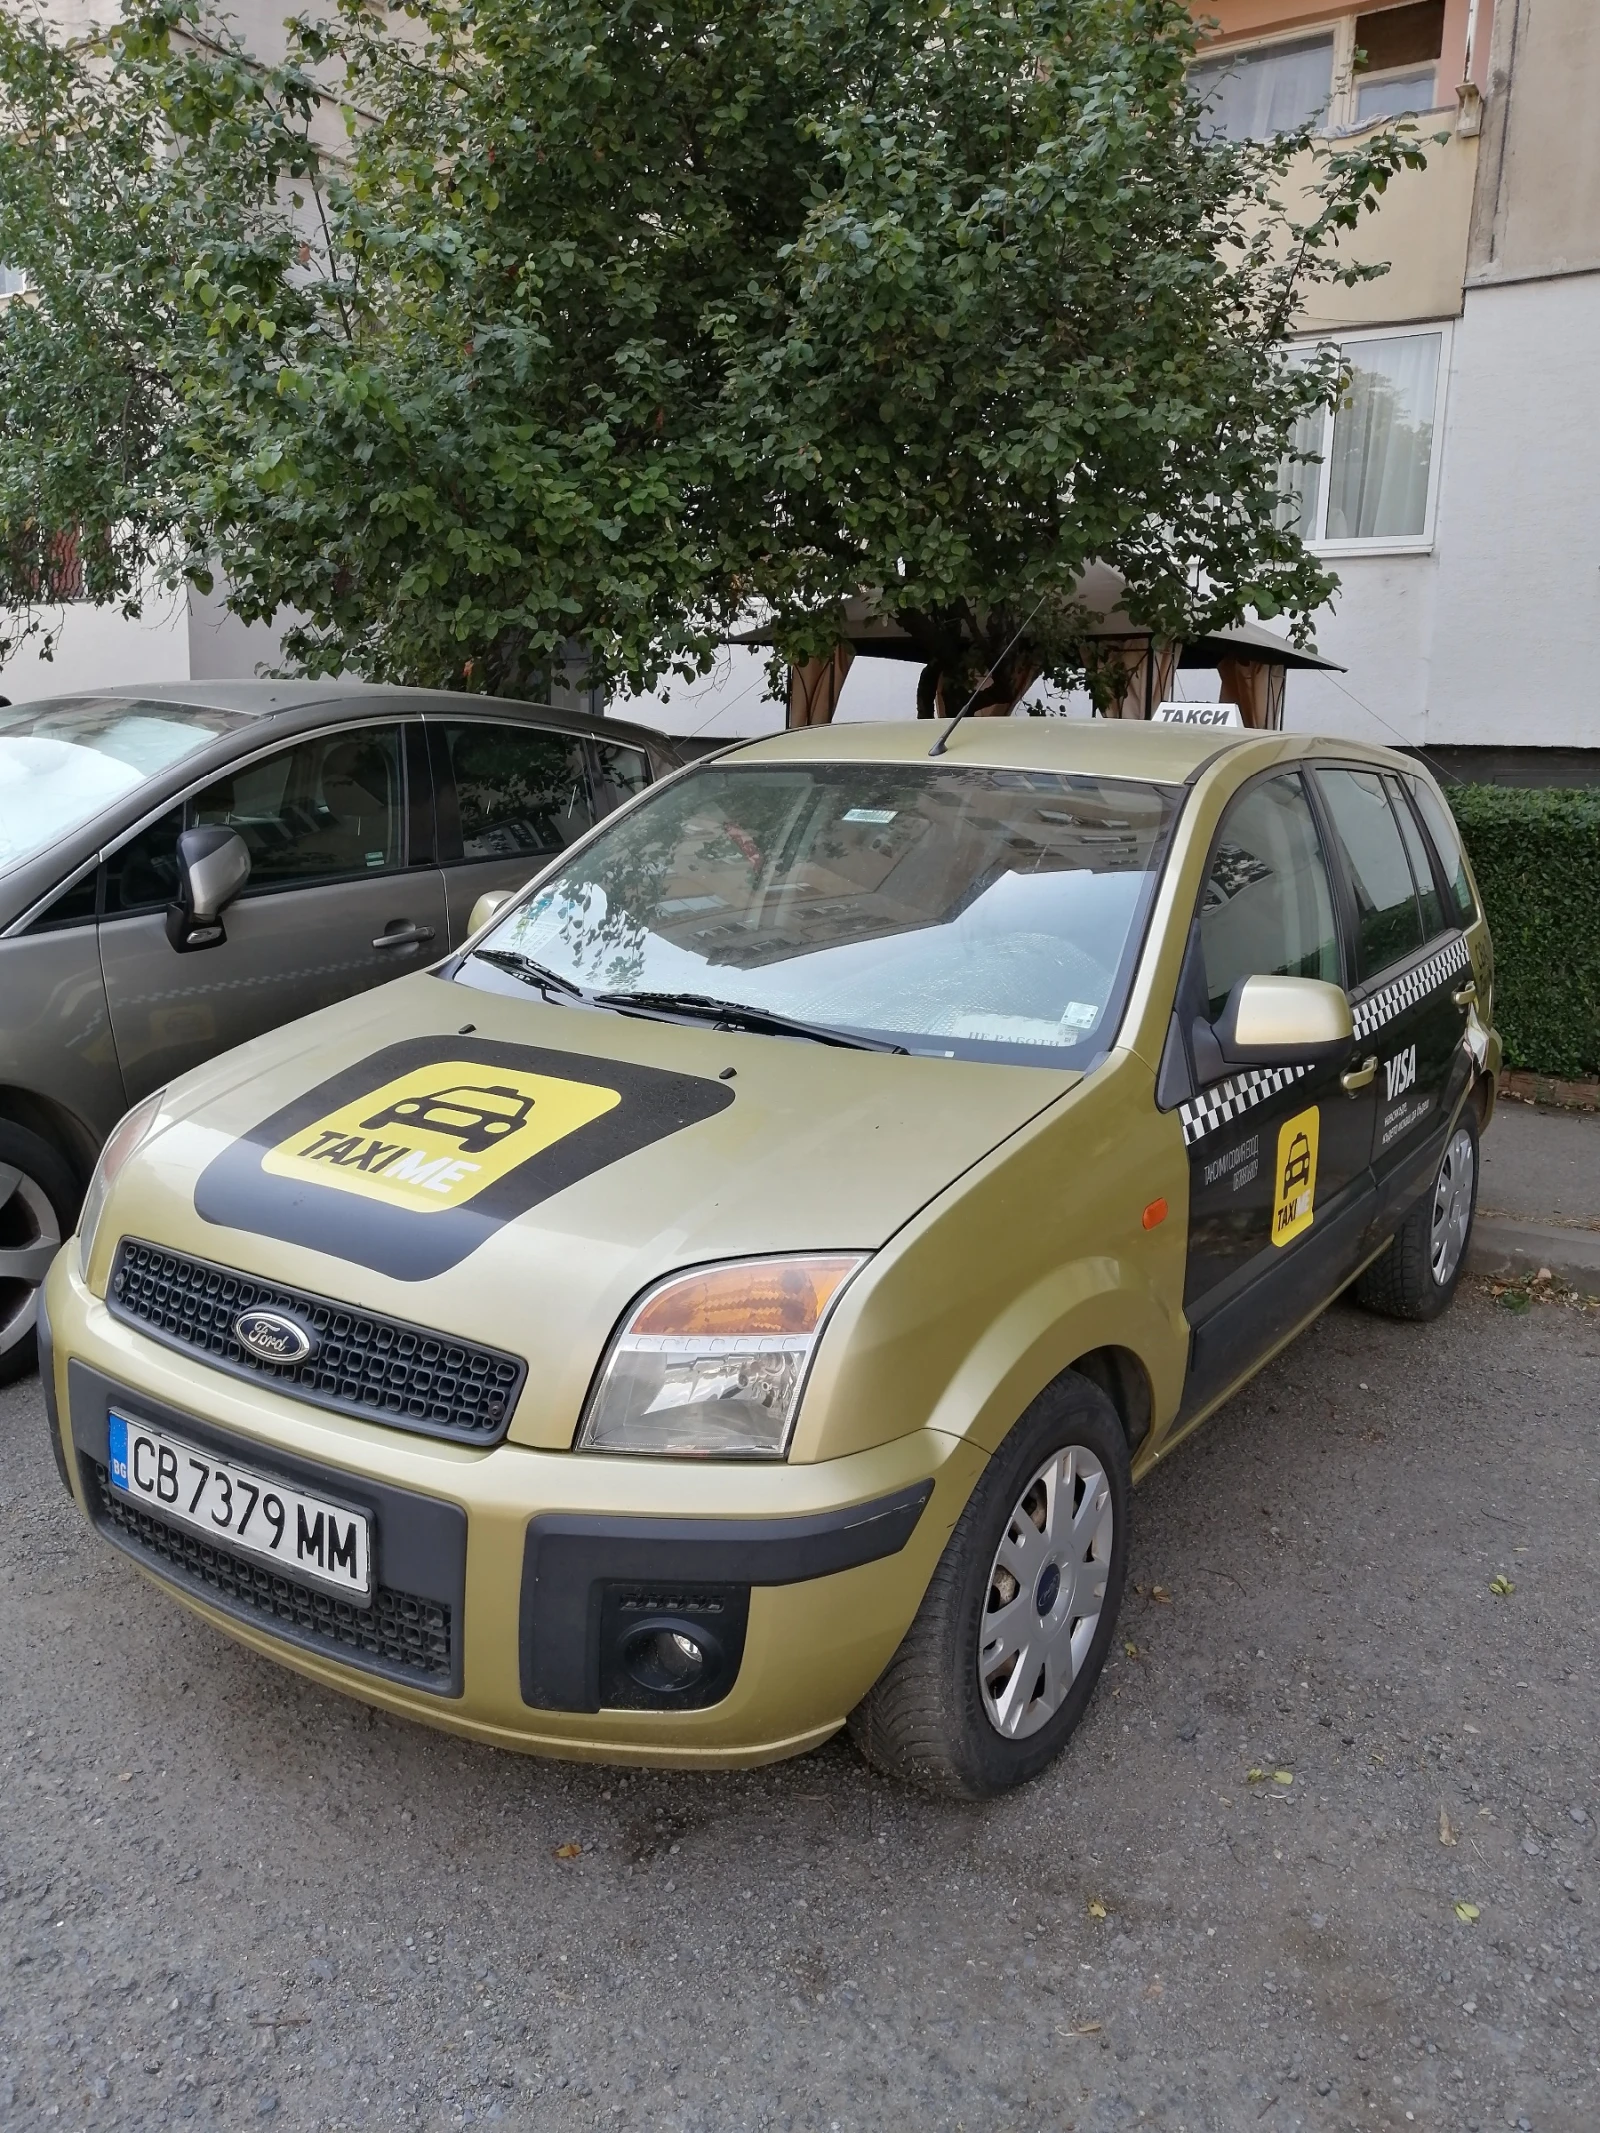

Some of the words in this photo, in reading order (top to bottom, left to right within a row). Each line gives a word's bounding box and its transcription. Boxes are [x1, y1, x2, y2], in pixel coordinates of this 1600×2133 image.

[1162, 709, 1230, 725] ТАКСИ
[1383, 1044, 1416, 1102] VISA
[248, 1321, 290, 1352] Ford
[113, 1458, 127, 1479] BG
